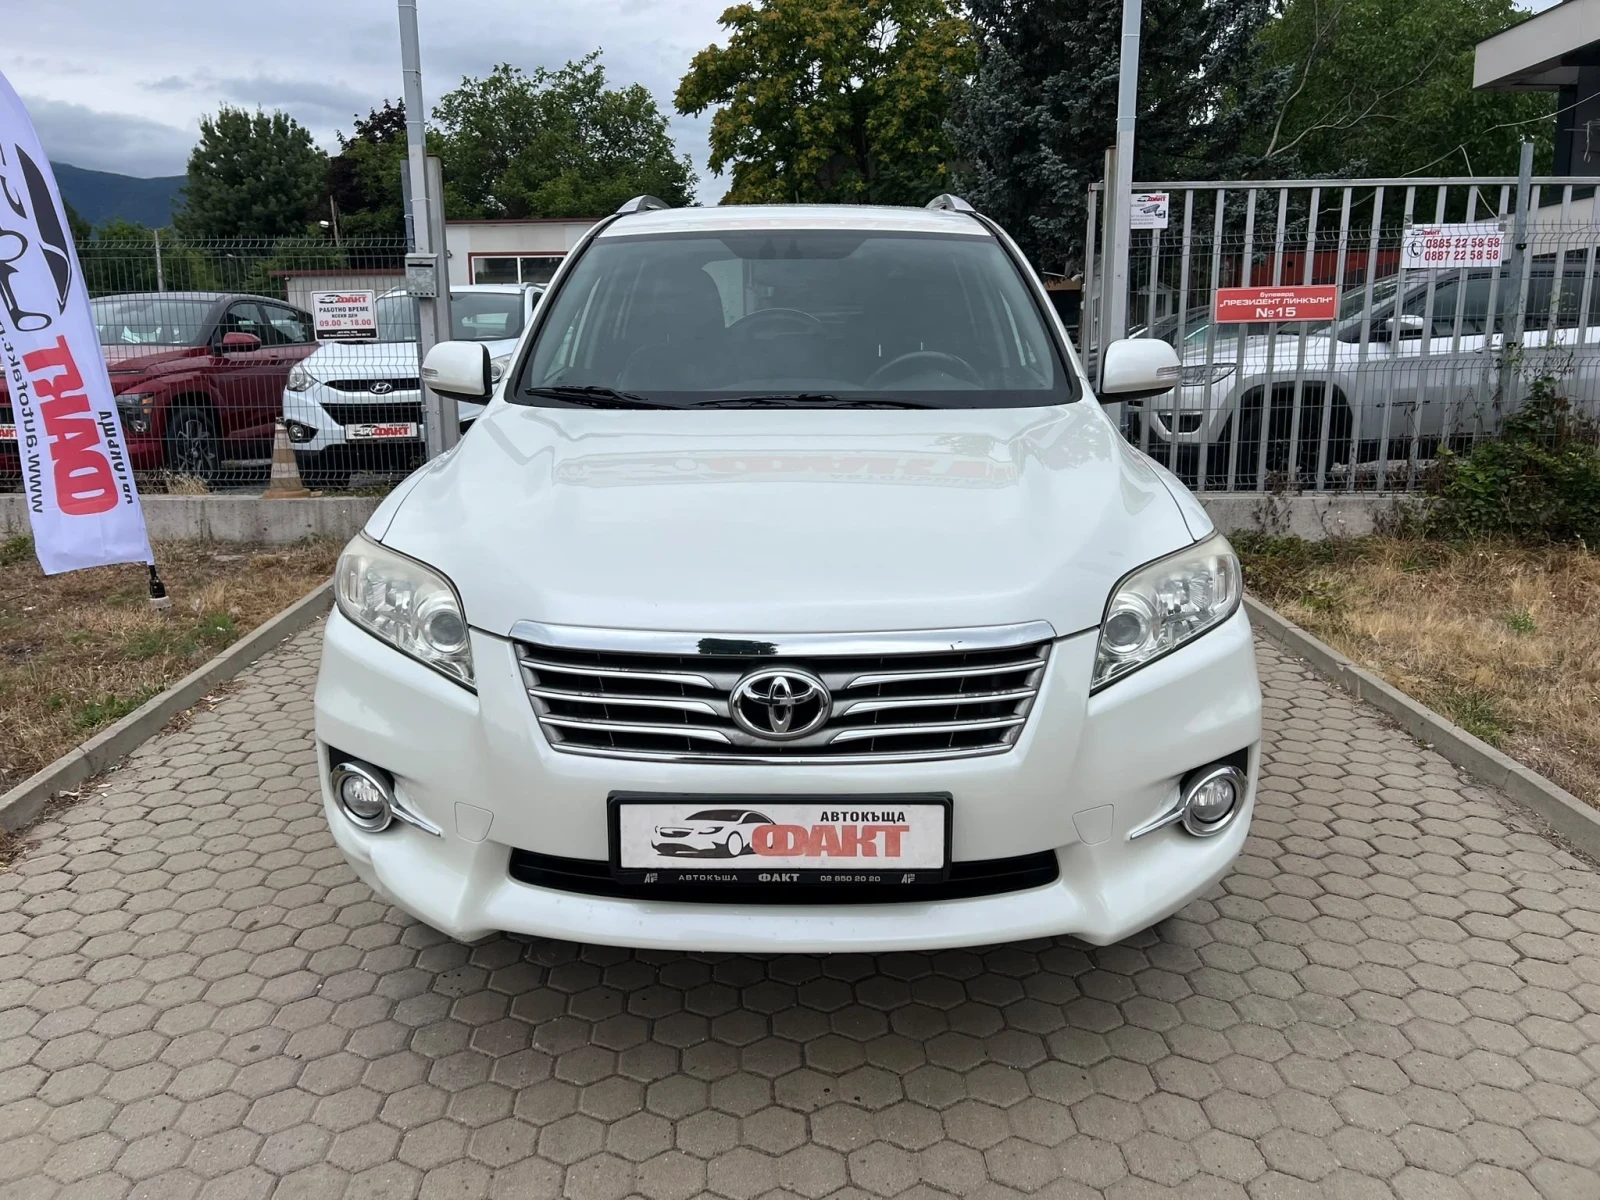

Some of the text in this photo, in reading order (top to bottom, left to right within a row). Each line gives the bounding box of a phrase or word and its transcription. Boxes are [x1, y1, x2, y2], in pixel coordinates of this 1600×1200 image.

[1426, 237, 1500, 249] 0885 22 58 58
[1424, 249, 1499, 261] 0887 22 58 58
[320, 319, 342, 327] 09.00
[350, 318, 372, 326] 18.00
[820, 811, 906, 824] АВТОКЪЩА
[752, 824, 910, 858] ФАКТ
[758, 873, 800, 882] ФАКТ
